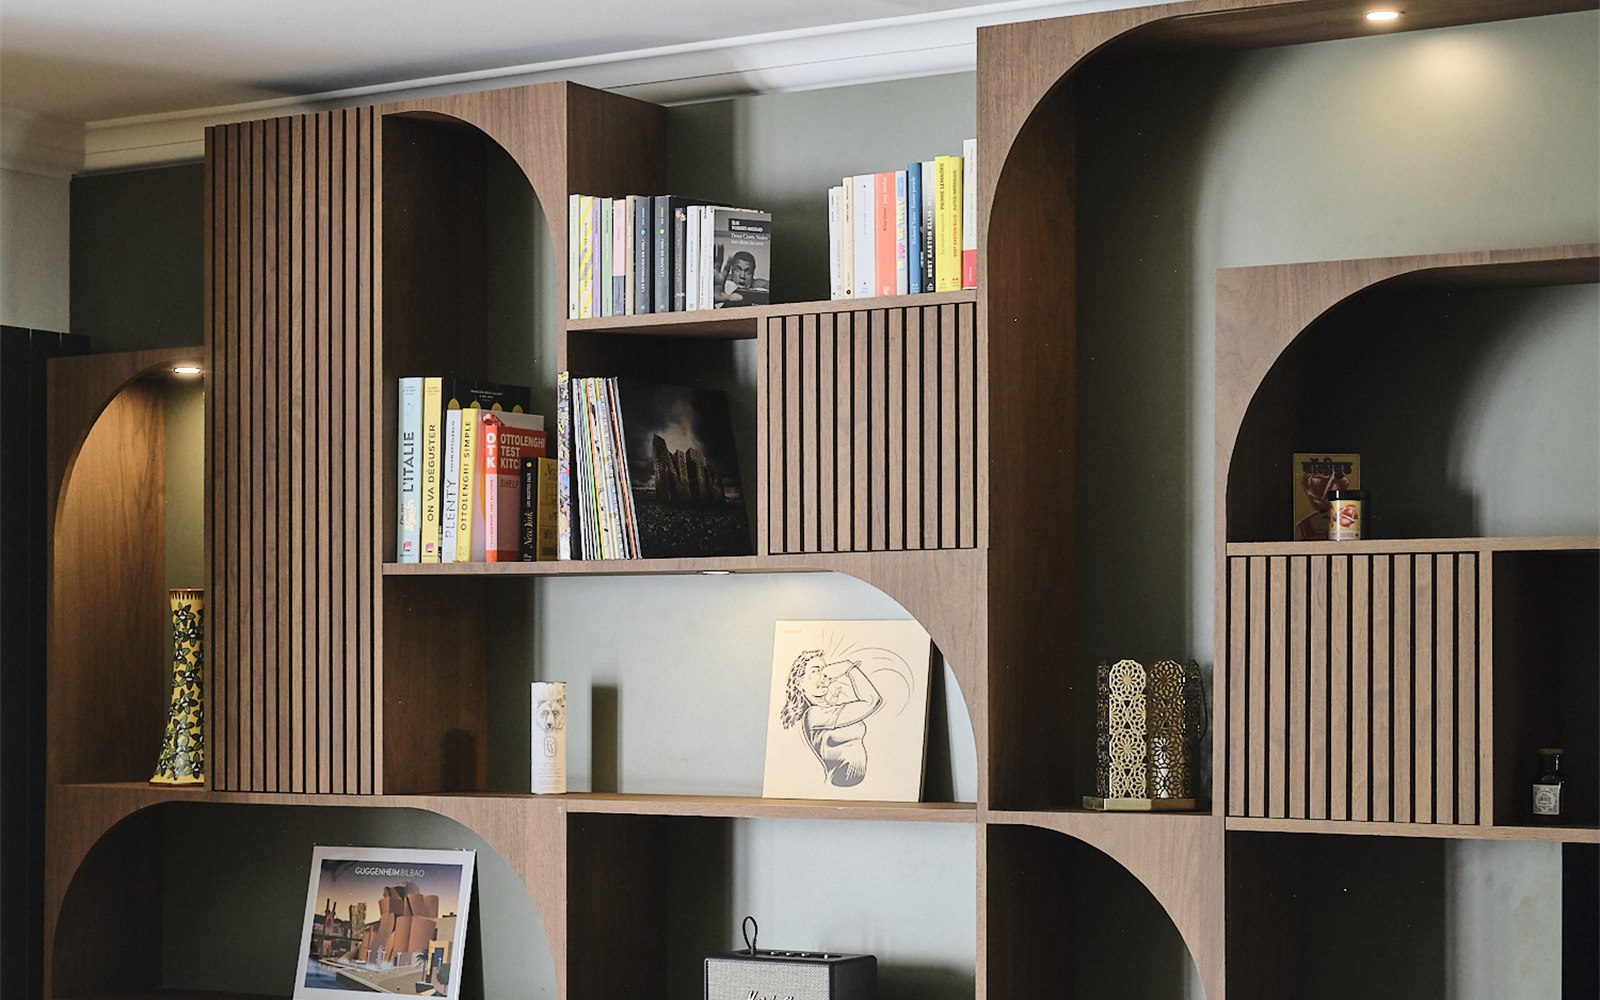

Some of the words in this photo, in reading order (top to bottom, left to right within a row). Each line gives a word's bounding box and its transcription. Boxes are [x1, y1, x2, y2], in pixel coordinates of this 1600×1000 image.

[500, 433, 545, 448] OTTOLENGHI
[428, 424, 436, 482] DÉGUSTER
[486, 433, 496, 468] OTK
[500, 446, 520, 457] TEST
[403, 432, 414, 492] L'ITALIE
[500, 458, 521, 470] KITC
[428, 488, 434, 501] VA
[460, 463, 469, 531] OTTOLENGHI
[427, 506, 434, 522] ON
[446, 479, 456, 538] PLENTY
[524, 511, 533, 527] York
[355, 867, 400, 876] GUGGENHEIM
[400, 869, 425, 877] BILBAO
